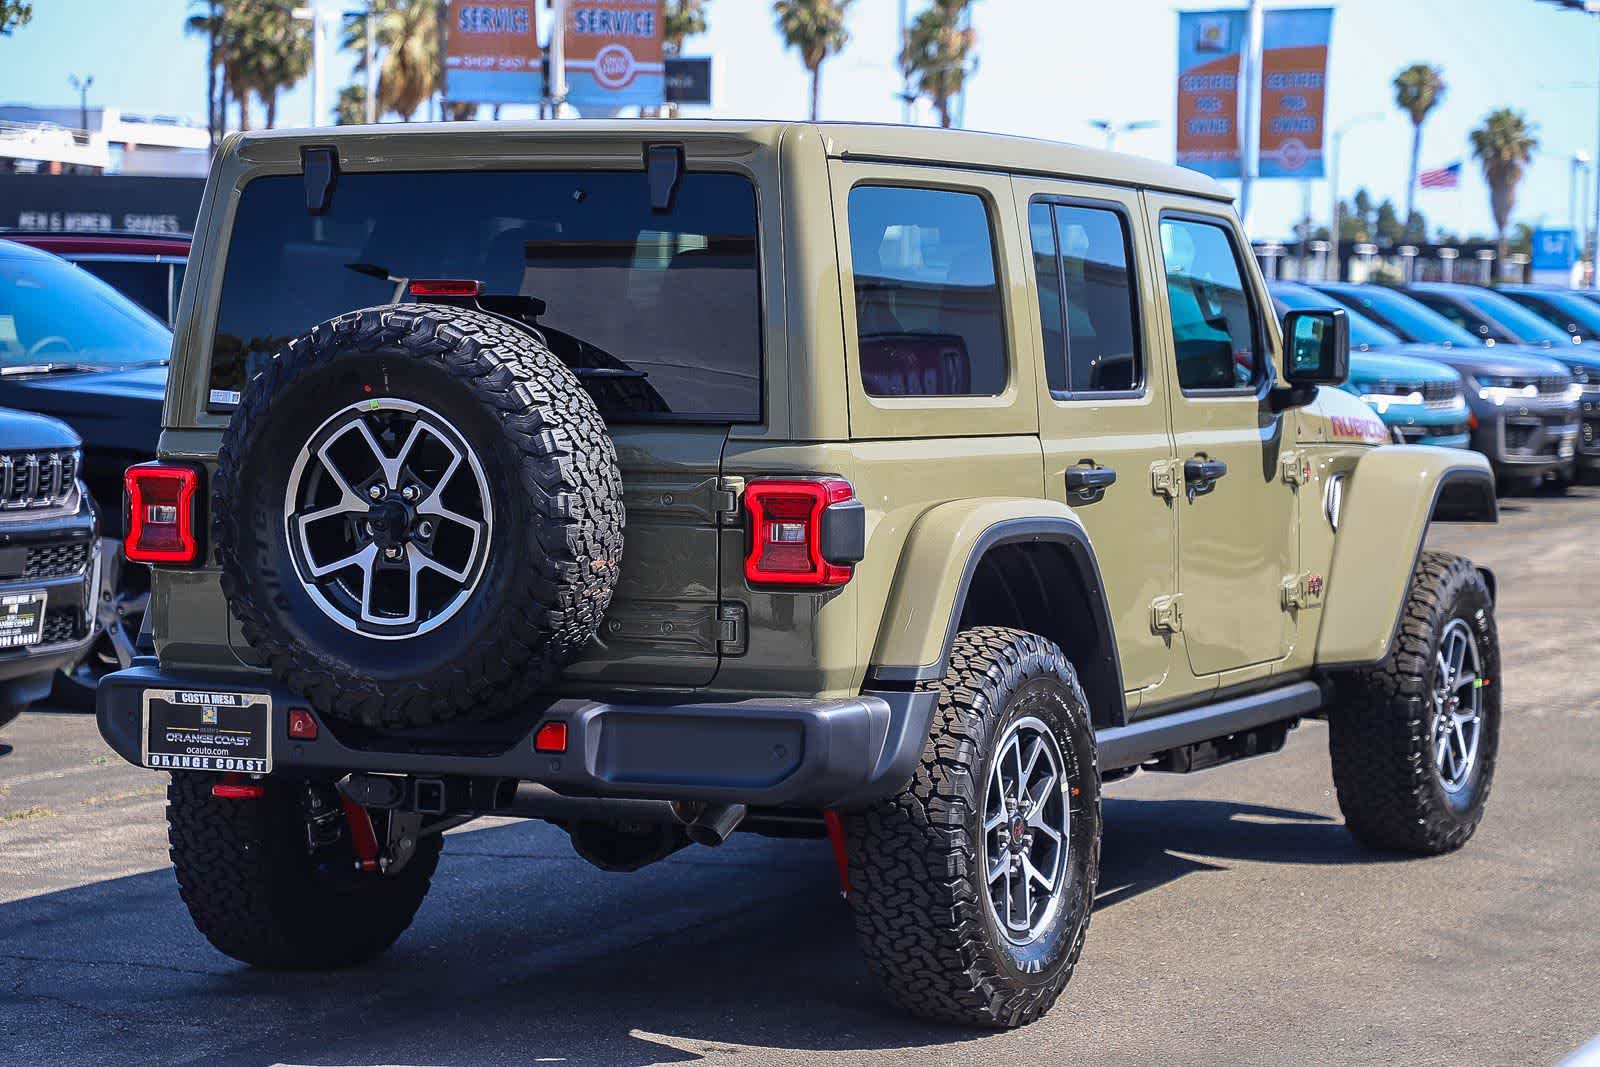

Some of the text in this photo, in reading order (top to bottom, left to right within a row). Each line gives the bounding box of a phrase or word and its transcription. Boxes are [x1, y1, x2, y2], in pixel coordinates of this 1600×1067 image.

[458, 7, 529, 33] SERVICE
[574, 8, 656, 36] SERVICE
[181, 693, 235, 705] COSTA MESA
[166, 732, 251, 746] ORANGE COAST
[186, 746, 229, 756] ocauto.com
[151, 755, 263, 771] ORANGE COAST
